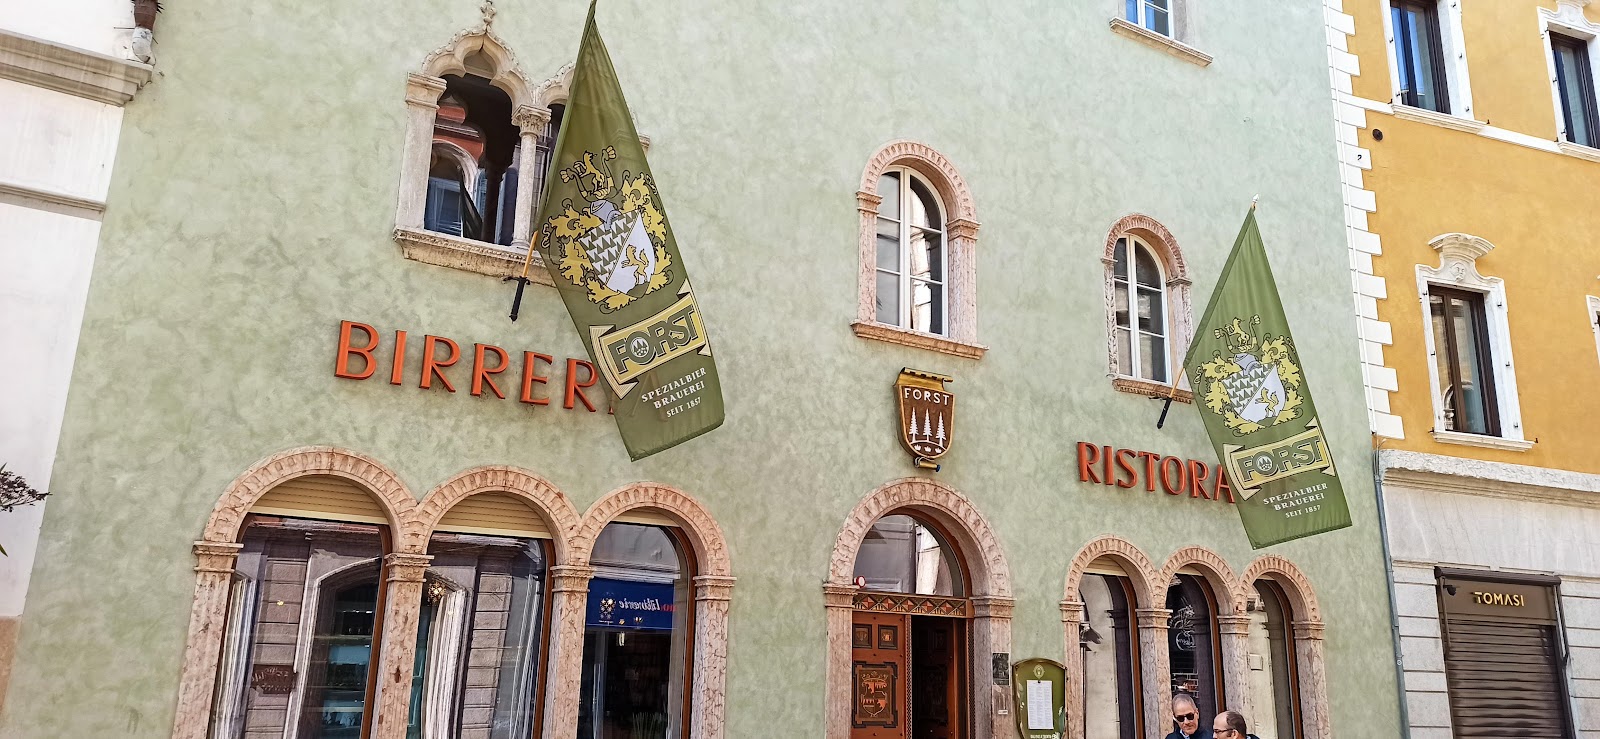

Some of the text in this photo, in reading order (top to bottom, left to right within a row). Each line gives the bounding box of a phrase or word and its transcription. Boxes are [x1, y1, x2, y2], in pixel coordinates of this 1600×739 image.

[607, 304, 698, 374] FORST
[335, 320, 614, 415] BIRRER
[641, 367, 707, 402] SPEZIALBIER
[653, 380, 705, 409] BRAUEREI
[904, 387, 950, 406] FORST
[666, 396, 701, 418] SEIT 1857
[1237, 435, 1323, 482] FORST
[1077, 441, 1236, 504] RISTORA
[1262, 482, 1328, 505] SPEZIALBIER
[1274, 492, 1325, 511] BRAUEREI
[1285, 504, 1321, 519] SEIT 1857
[1474, 591, 1525, 607] TOMASI
